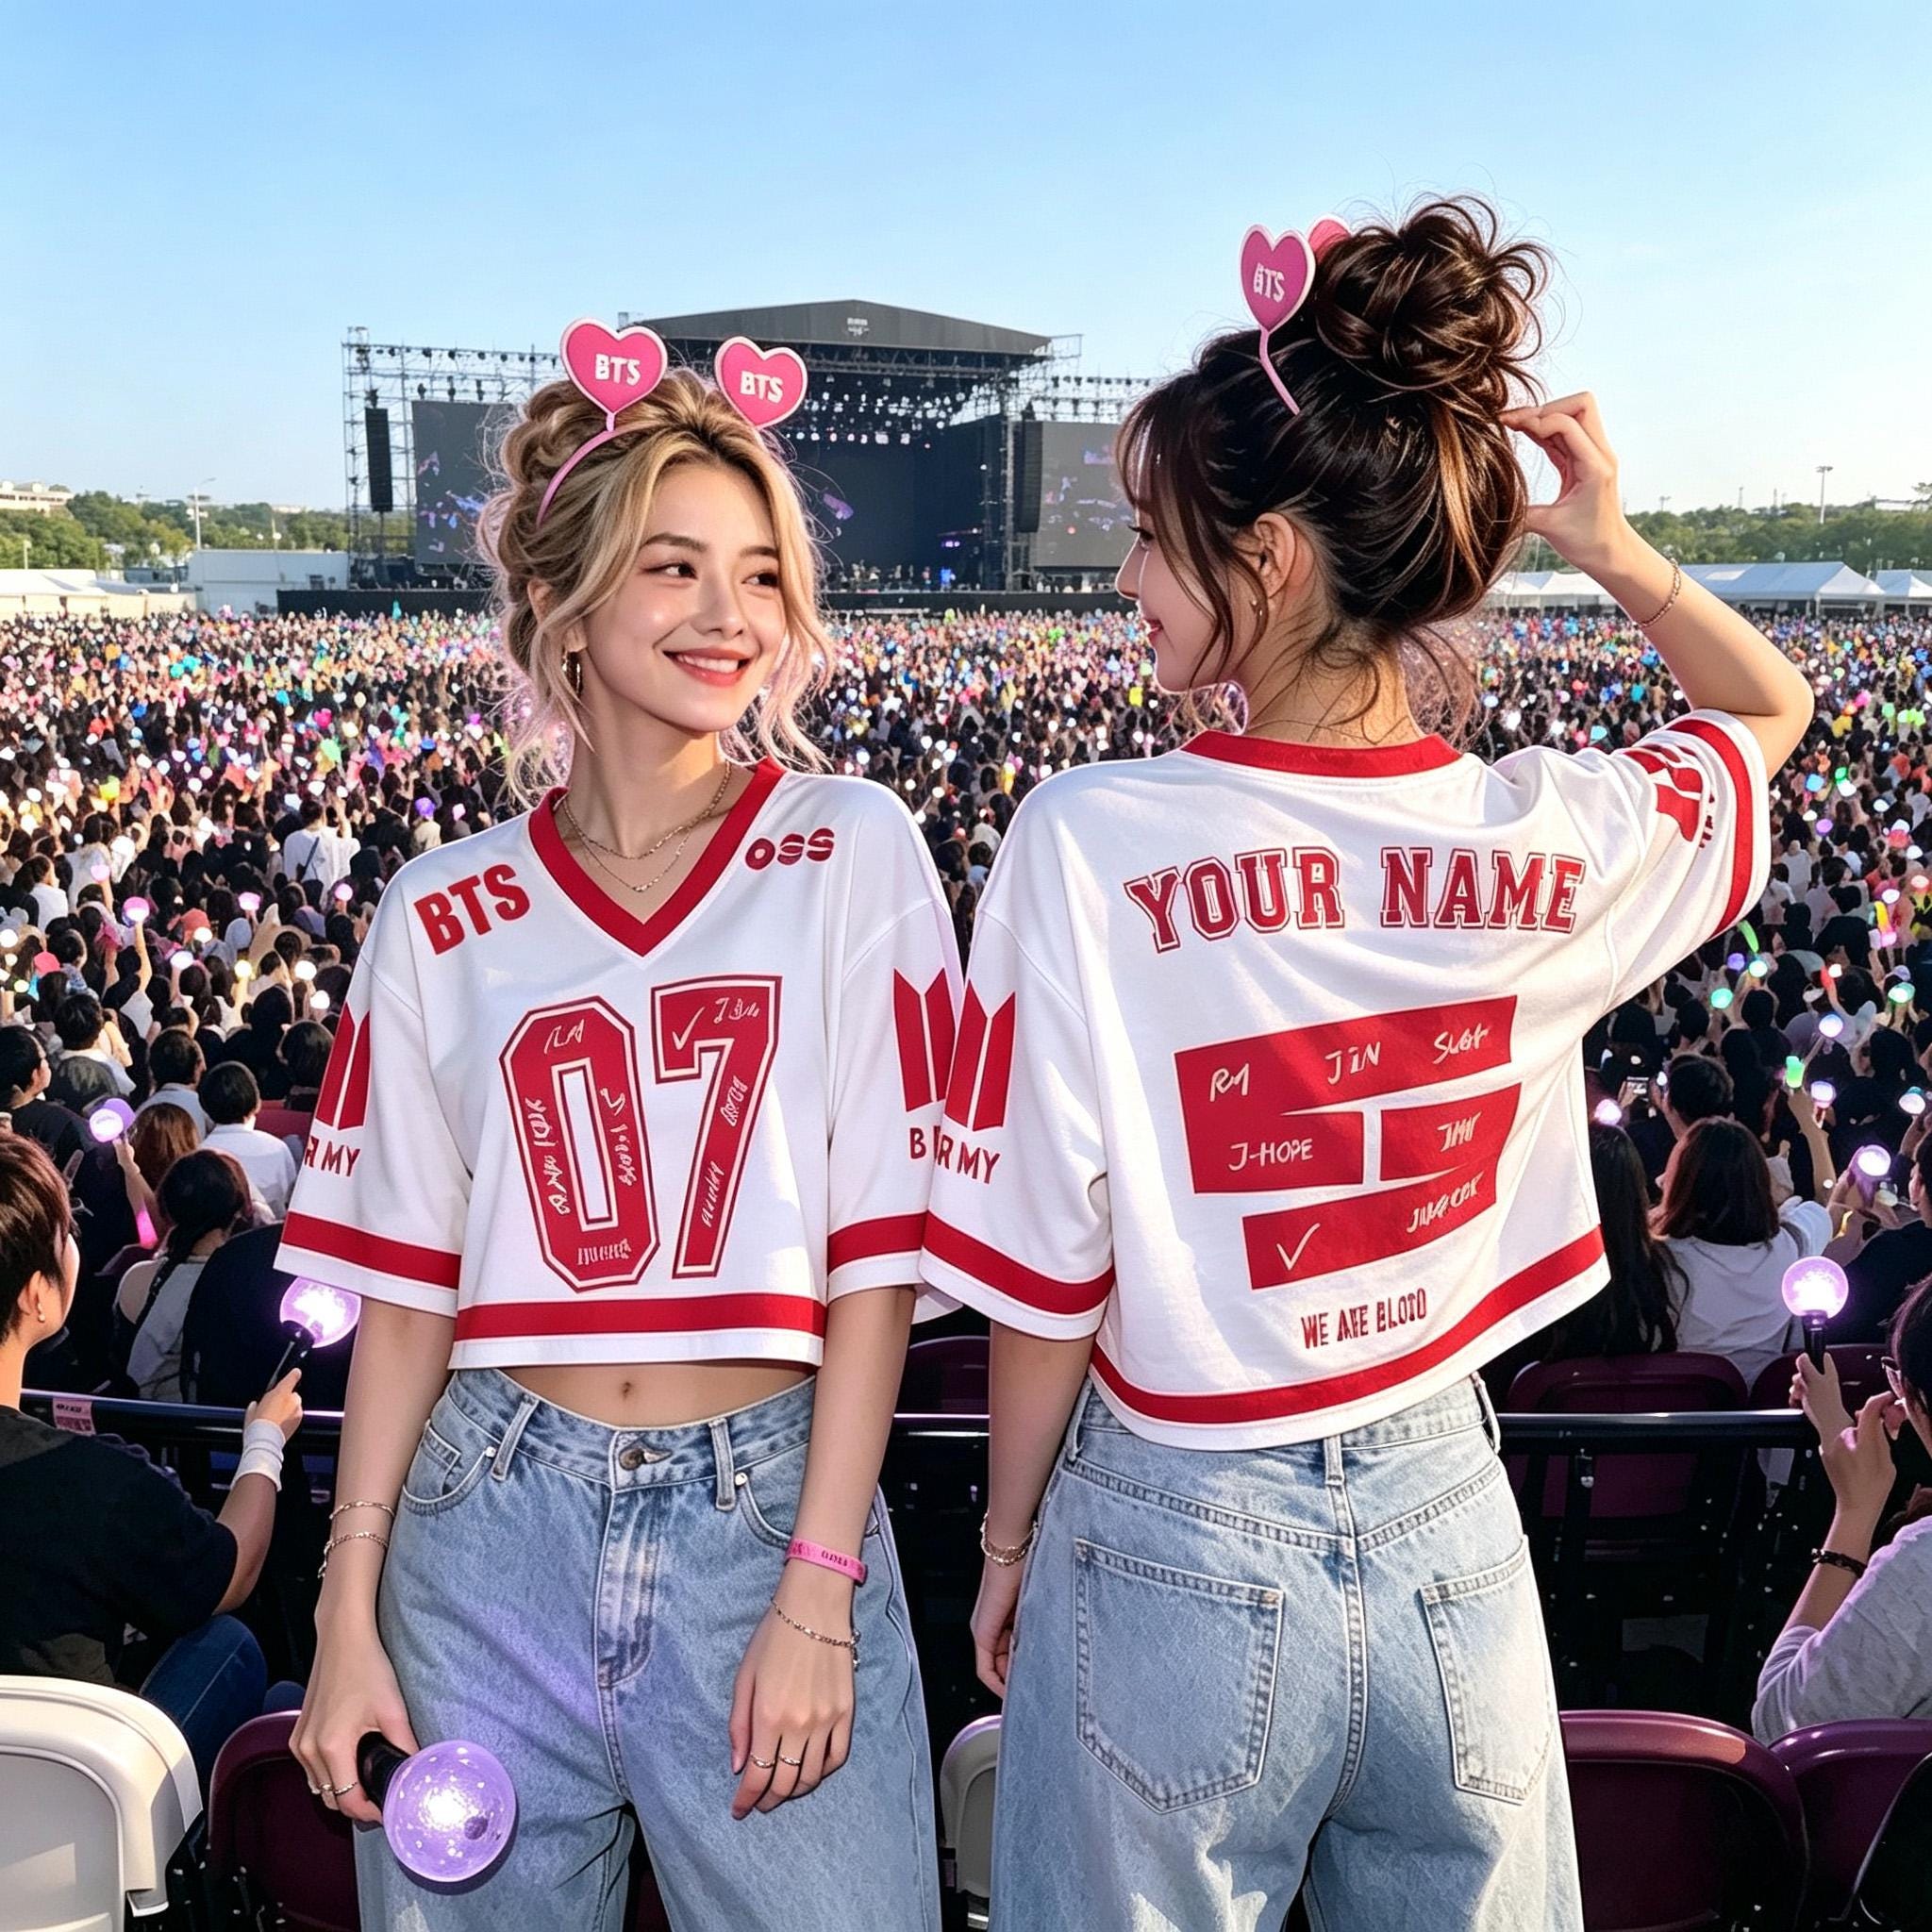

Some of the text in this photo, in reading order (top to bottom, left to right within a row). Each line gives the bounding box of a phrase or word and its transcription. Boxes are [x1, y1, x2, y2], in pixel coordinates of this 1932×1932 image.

[1253, 261, 1285, 303] BTS
[594, 353, 641, 386] BTS
[740, 371, 784, 404] BTS
[413, 863, 531, 956] BTS
[1124, 846, 1585, 954] YOUR NAME
[498, 974, 783, 1293] 07
[1228, 1138, 1313, 1172] J-HOPE
[1301, 1311, 1328, 1349] WE
